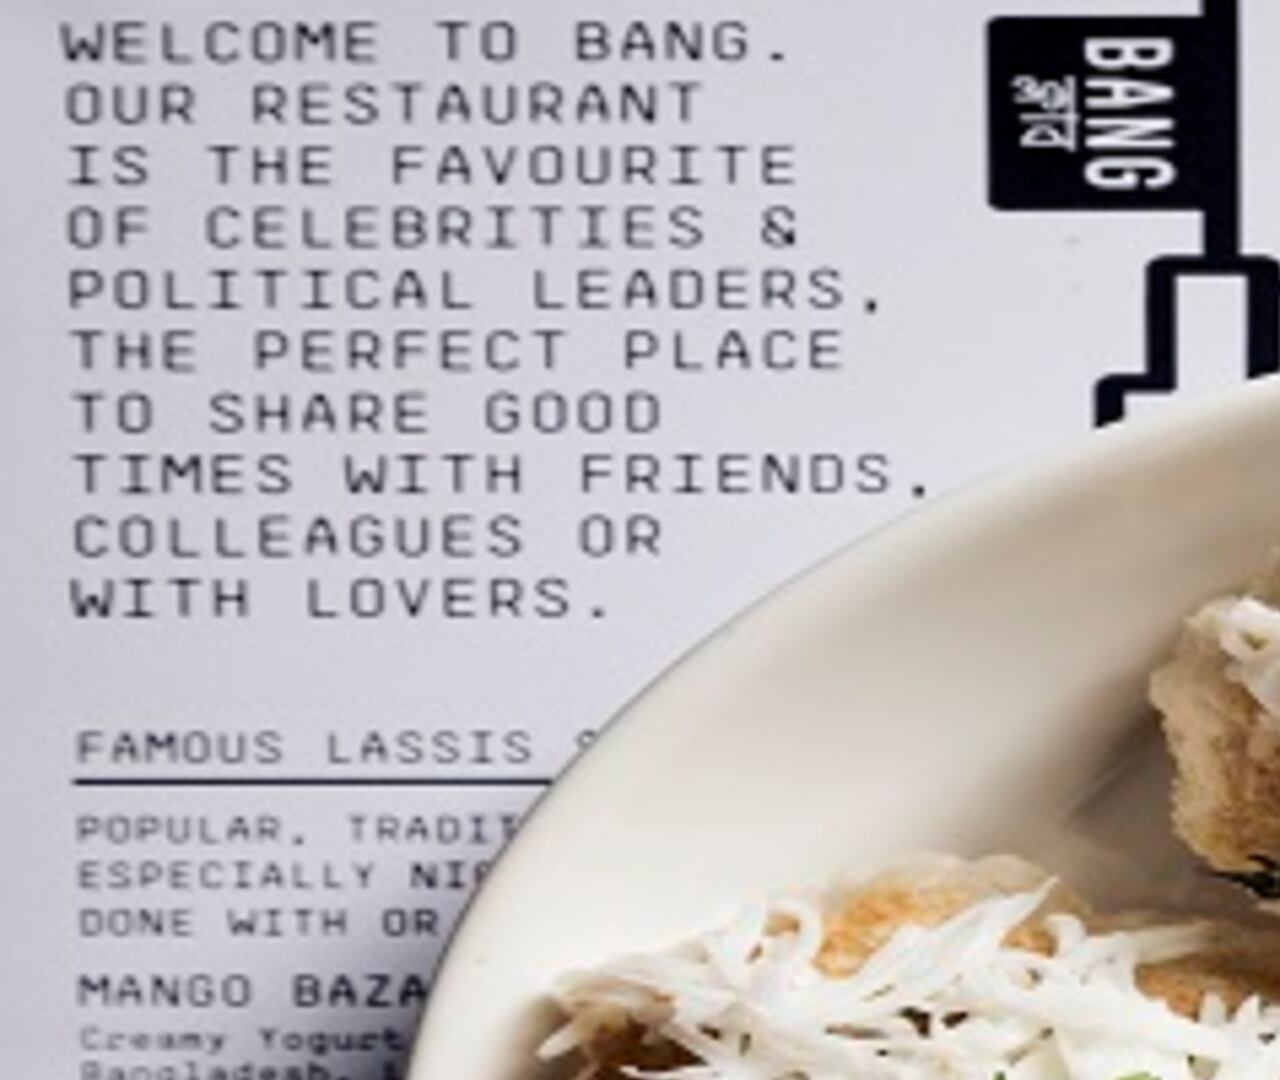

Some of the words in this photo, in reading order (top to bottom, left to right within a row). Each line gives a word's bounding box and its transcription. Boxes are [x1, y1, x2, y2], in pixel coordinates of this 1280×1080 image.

[58, 19, 377, 66] WELCOME
[435, 19, 518, 64] TO
[574, 19, 786, 63] BANG.
[64, 82, 196, 127] OUR
[251, 80, 699, 127] RESTAURANT
[1083, 36, 1176, 190] BANG
[70, 143, 150, 188] IS
[206, 143, 333, 187] THE
[391, 143, 794, 187] FAVOURITE
[66, 204, 148, 251] OF
[204, 203, 705, 251] CELEBRITIES
[760, 204, 797, 248] &
[68, 267, 473, 312] POLITICAL
[68, 328, 196, 374] THE
[253, 327, 565, 374] PERFECT
[623, 328, 841, 372] PLACE
[74, 391, 154, 436] TO
[208, 390, 428, 436] SHARE
[483, 389, 662, 436] GOOD
[72, 452, 294, 496] TIMES
[342, 452, 522, 496] WITH
[72, 512, 523, 560] COLLEAGUES
[577, 512, 662, 560] OR
[68, 576, 248, 620] WITH
[305, 576, 606, 620] LOVERS.
[76, 728, 284, 766] FAMOUS
[326, 728, 533, 766] LASSIS
[76, 858, 373, 891] ESPECIALLY
[77, 906, 192, 940] DONE
[226, 906, 348, 939] WITH
[380, 907, 440, 939] OR
[77, 972, 253, 1010] MANGO
[77, 1024, 226, 1056] Creamy
